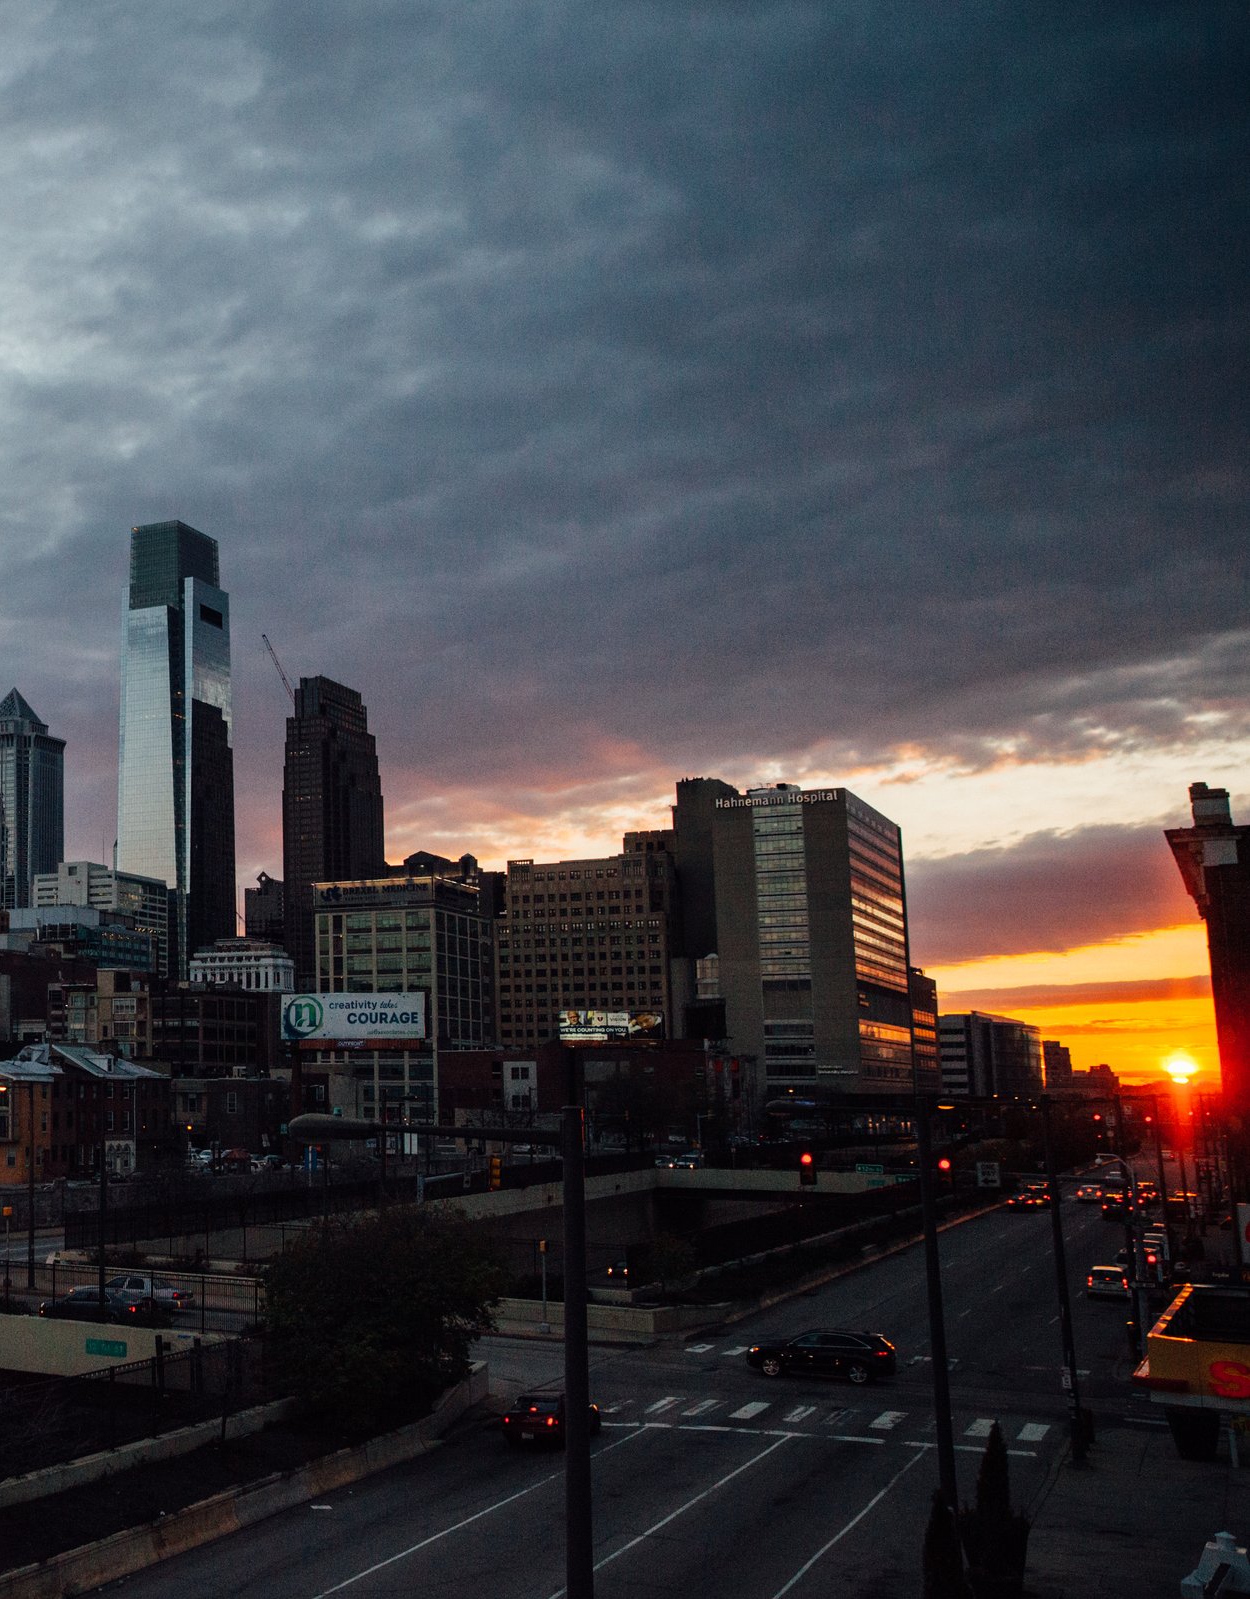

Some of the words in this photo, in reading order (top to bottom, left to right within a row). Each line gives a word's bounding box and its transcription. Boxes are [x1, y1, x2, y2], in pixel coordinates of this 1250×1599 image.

[715, 796, 784, 809] Hahnemann
[787, 790, 838, 805] Hospital
[342, 886, 379, 896] DREXEL
[382, 883, 429, 894] MEDICINE
[328, 1000, 378, 1010] creativity
[379, 999, 398, 1010] takes
[347, 1012, 419, 1025] COURAGE
